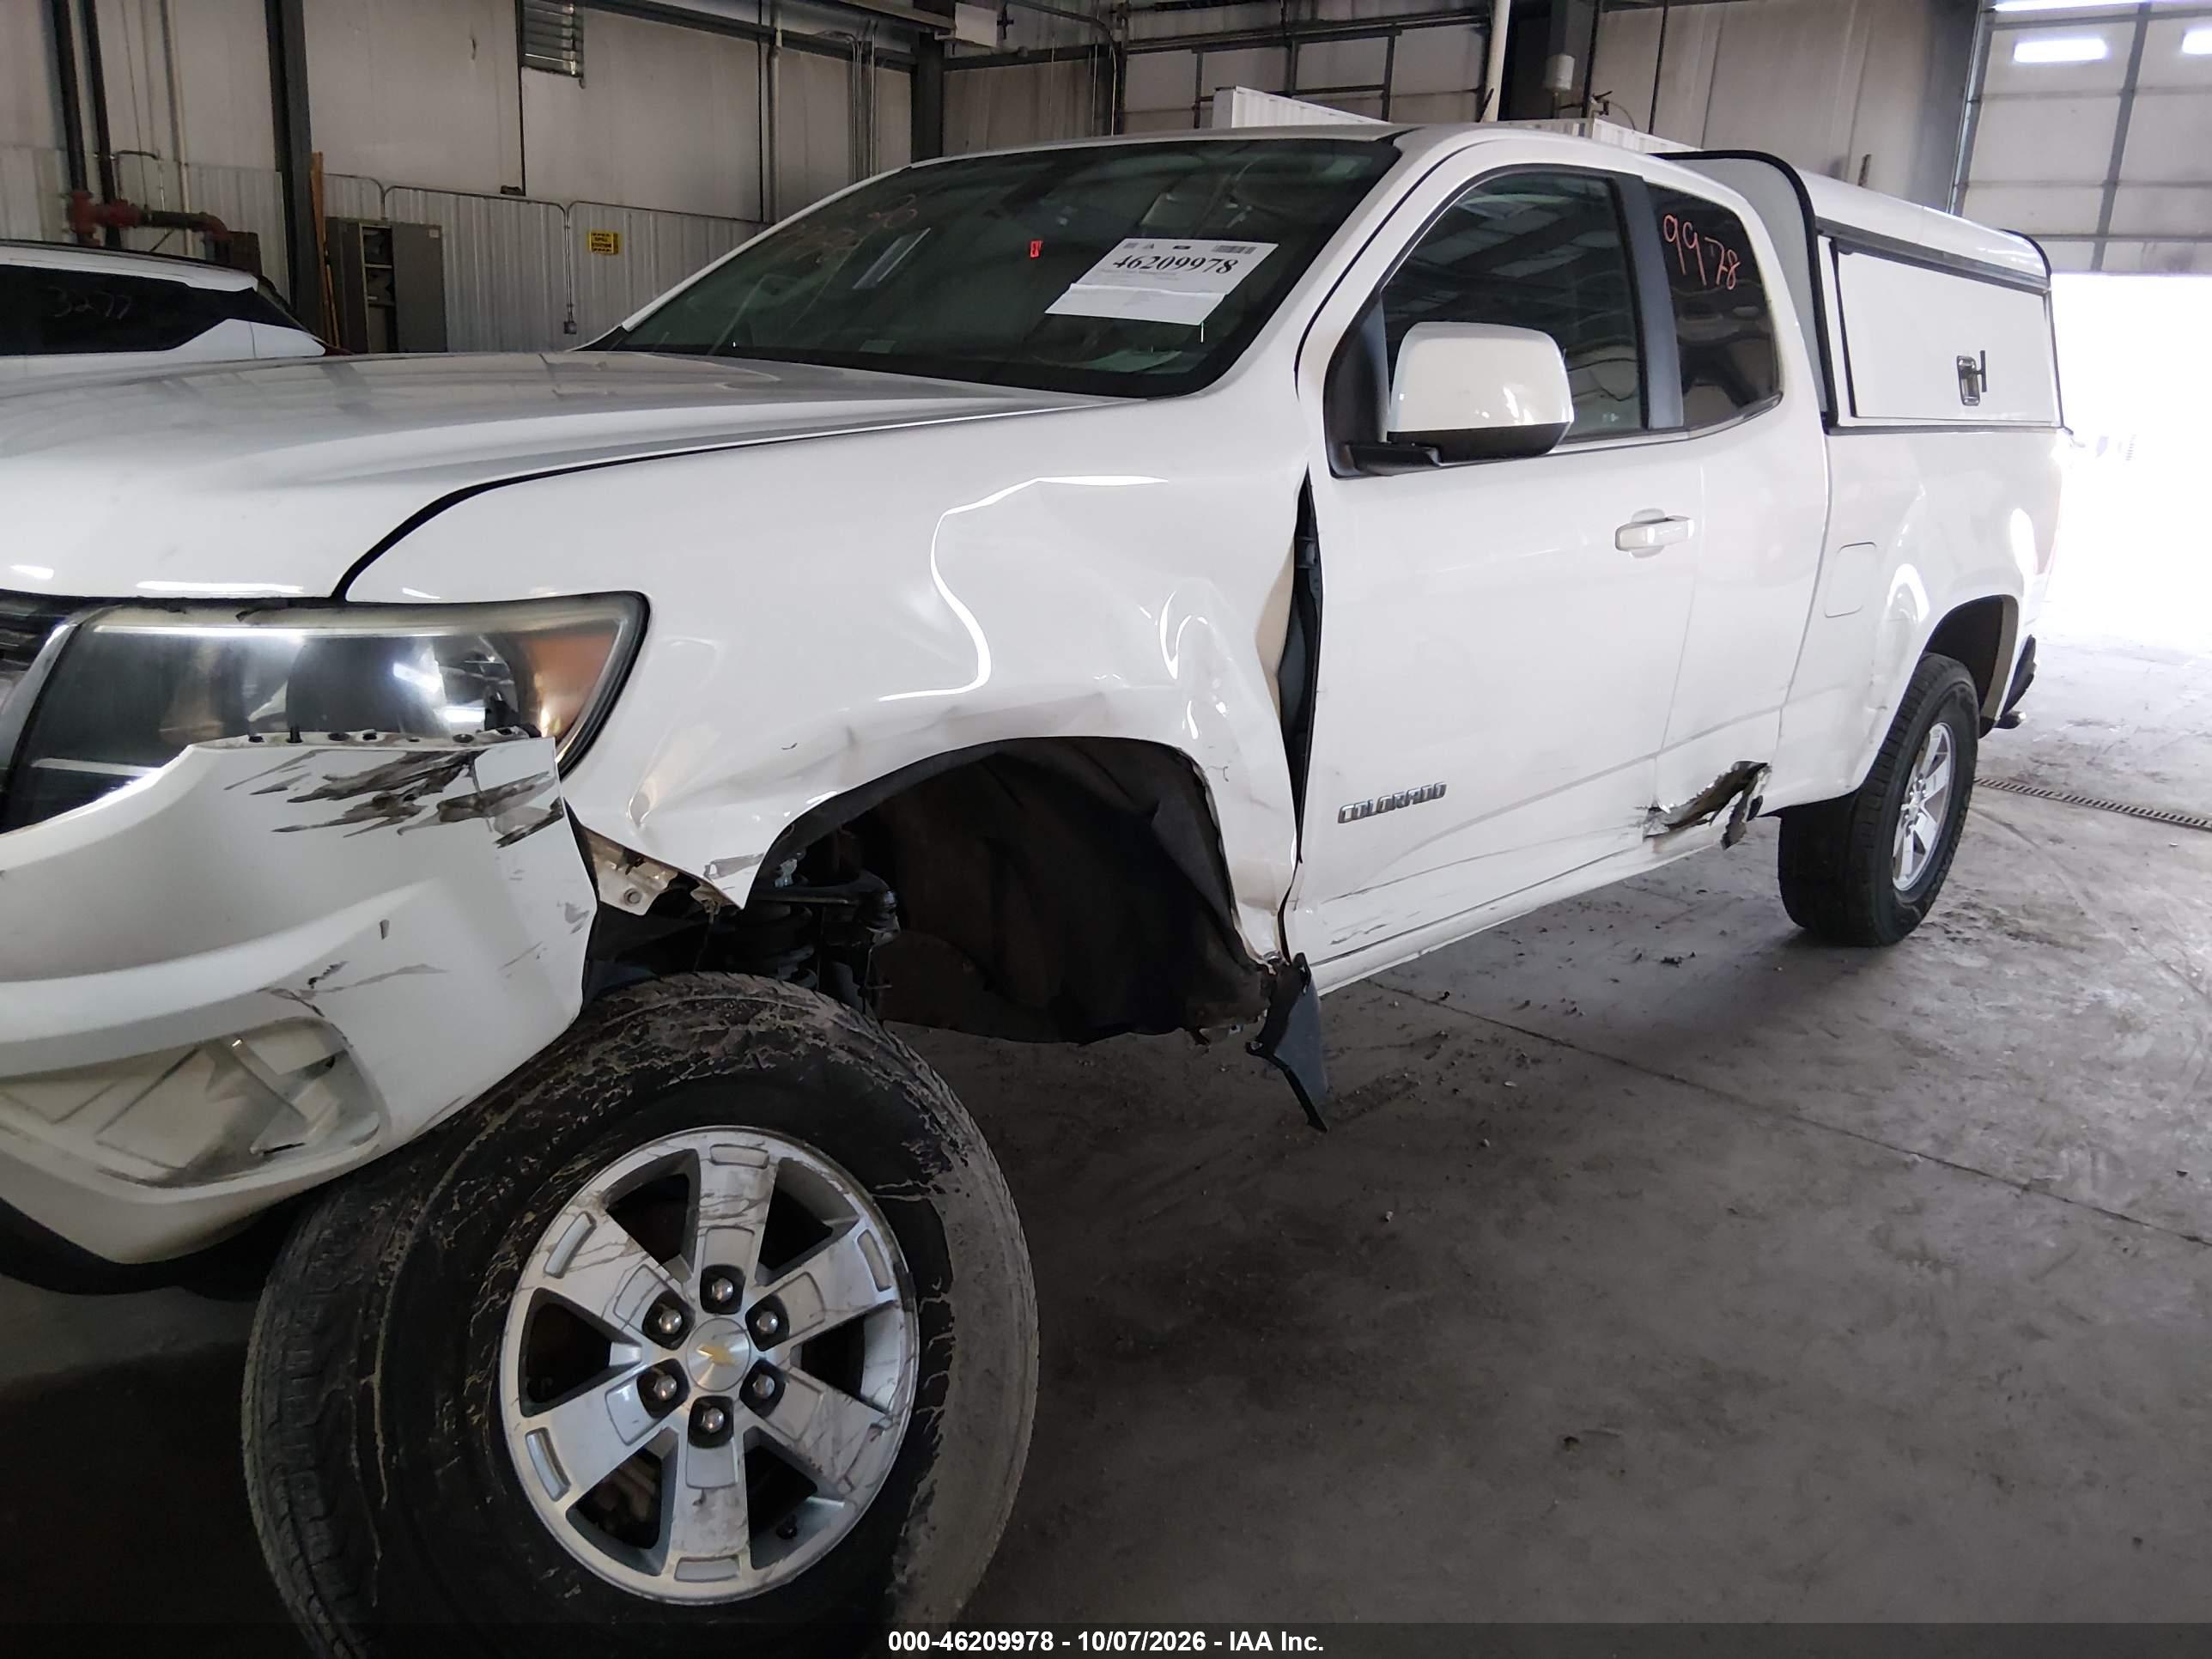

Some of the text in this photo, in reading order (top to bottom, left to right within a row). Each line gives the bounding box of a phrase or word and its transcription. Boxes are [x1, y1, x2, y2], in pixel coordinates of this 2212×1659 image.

[1113, 254, 1239, 274] 46209978
[1663, 214, 1741, 290] 9978
[1338, 781, 1448, 824] COLORADO
